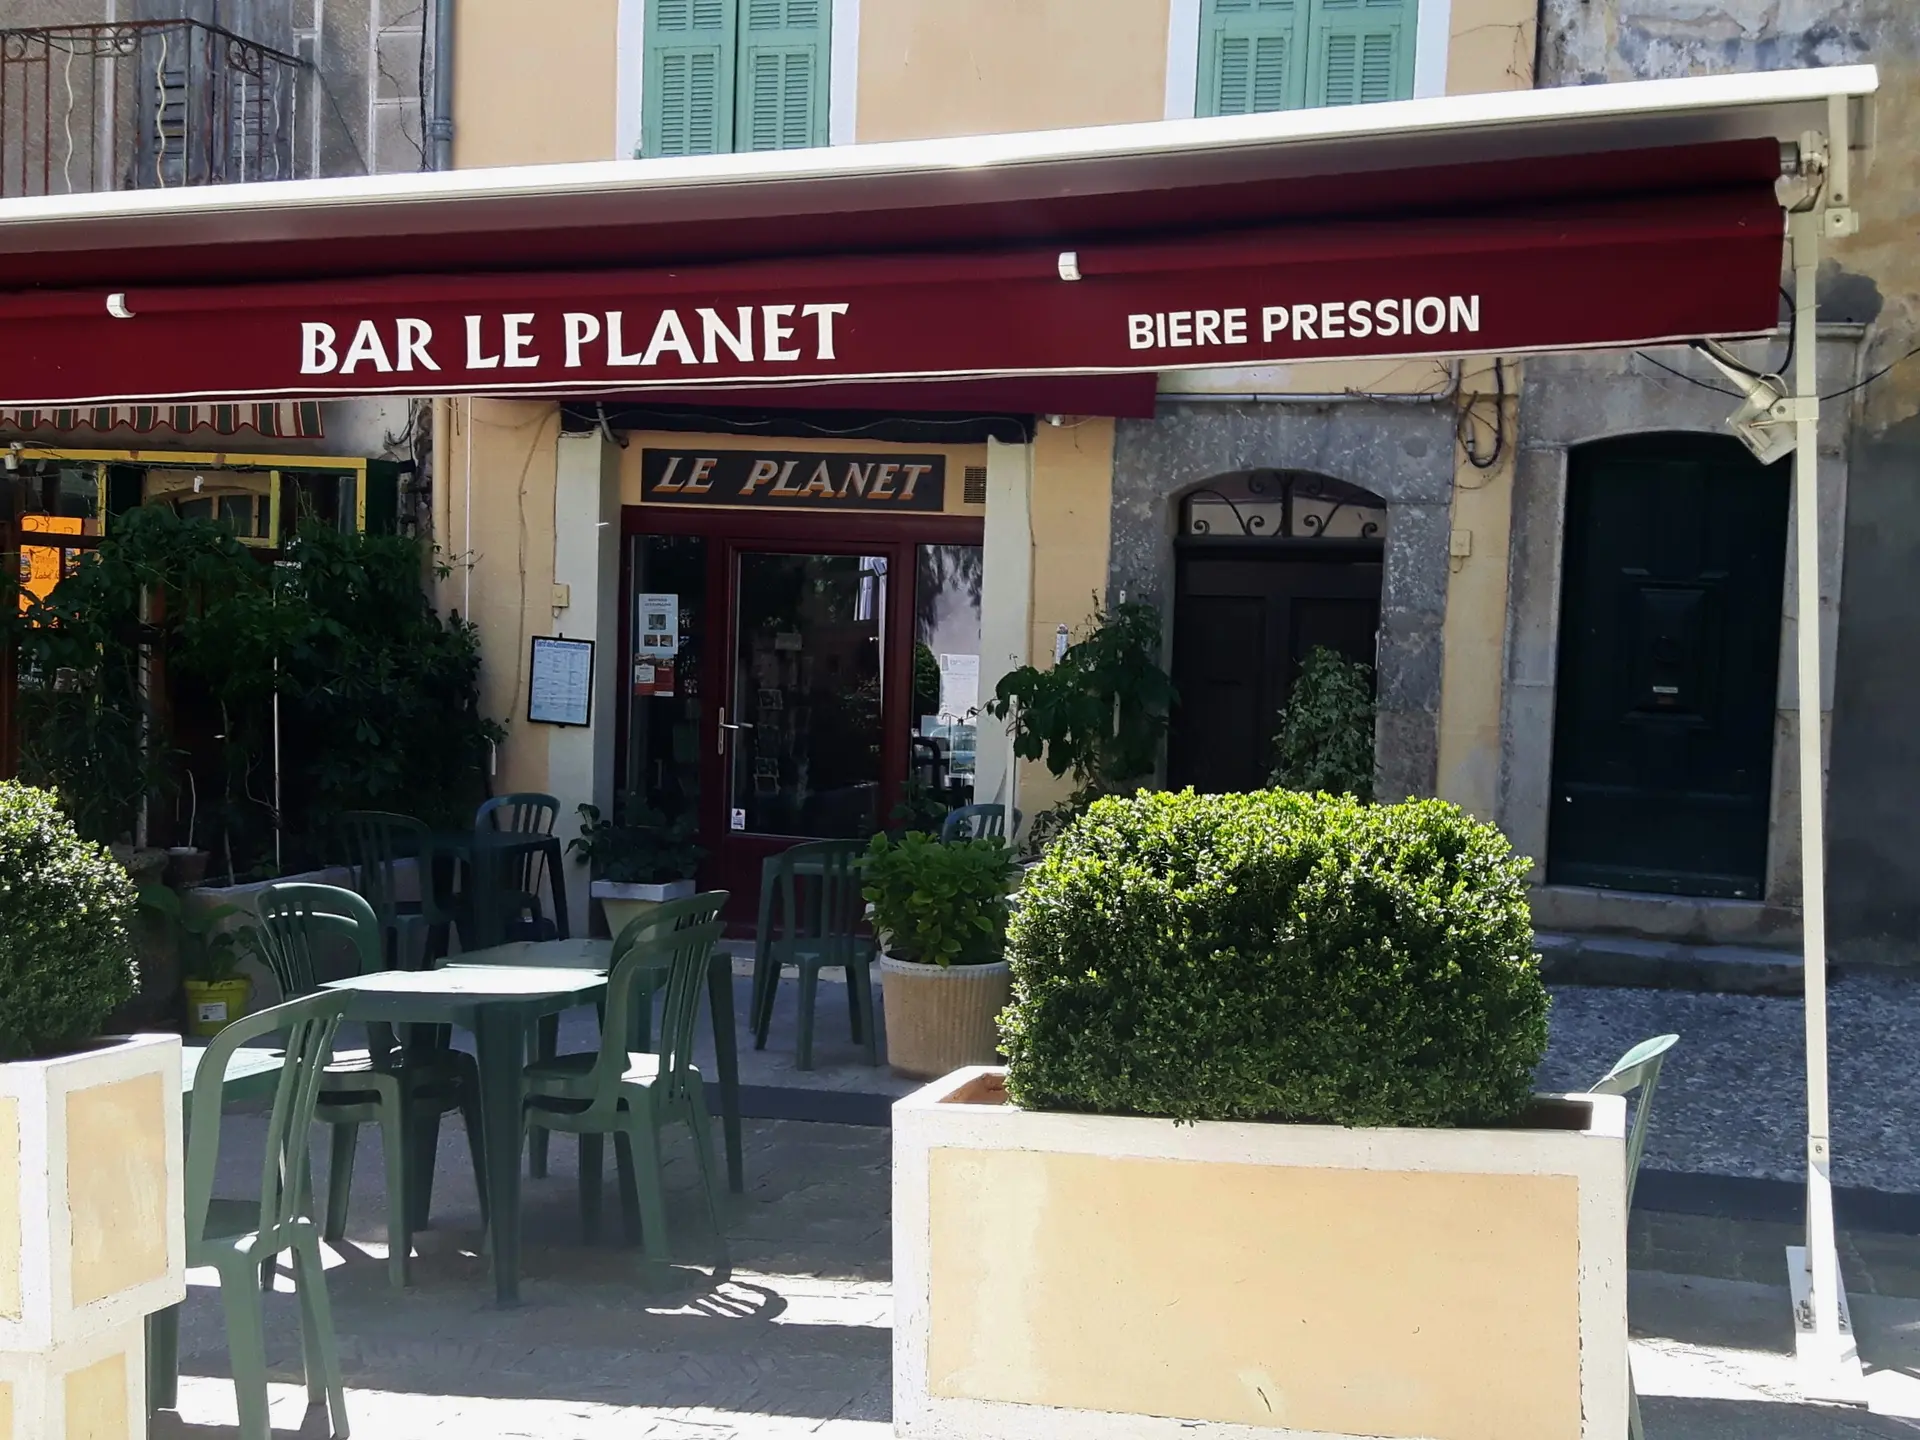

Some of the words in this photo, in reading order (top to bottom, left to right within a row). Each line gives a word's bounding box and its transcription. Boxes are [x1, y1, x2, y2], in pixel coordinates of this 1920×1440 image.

[300, 318, 441, 374] BAR
[465, 313, 539, 369] LE
[563, 303, 849, 367] PLANET
[1128, 308, 1247, 349] BIERE
[1263, 295, 1479, 342] PRESSION
[652, 457, 718, 493] LE
[738, 459, 932, 500] PLANET
